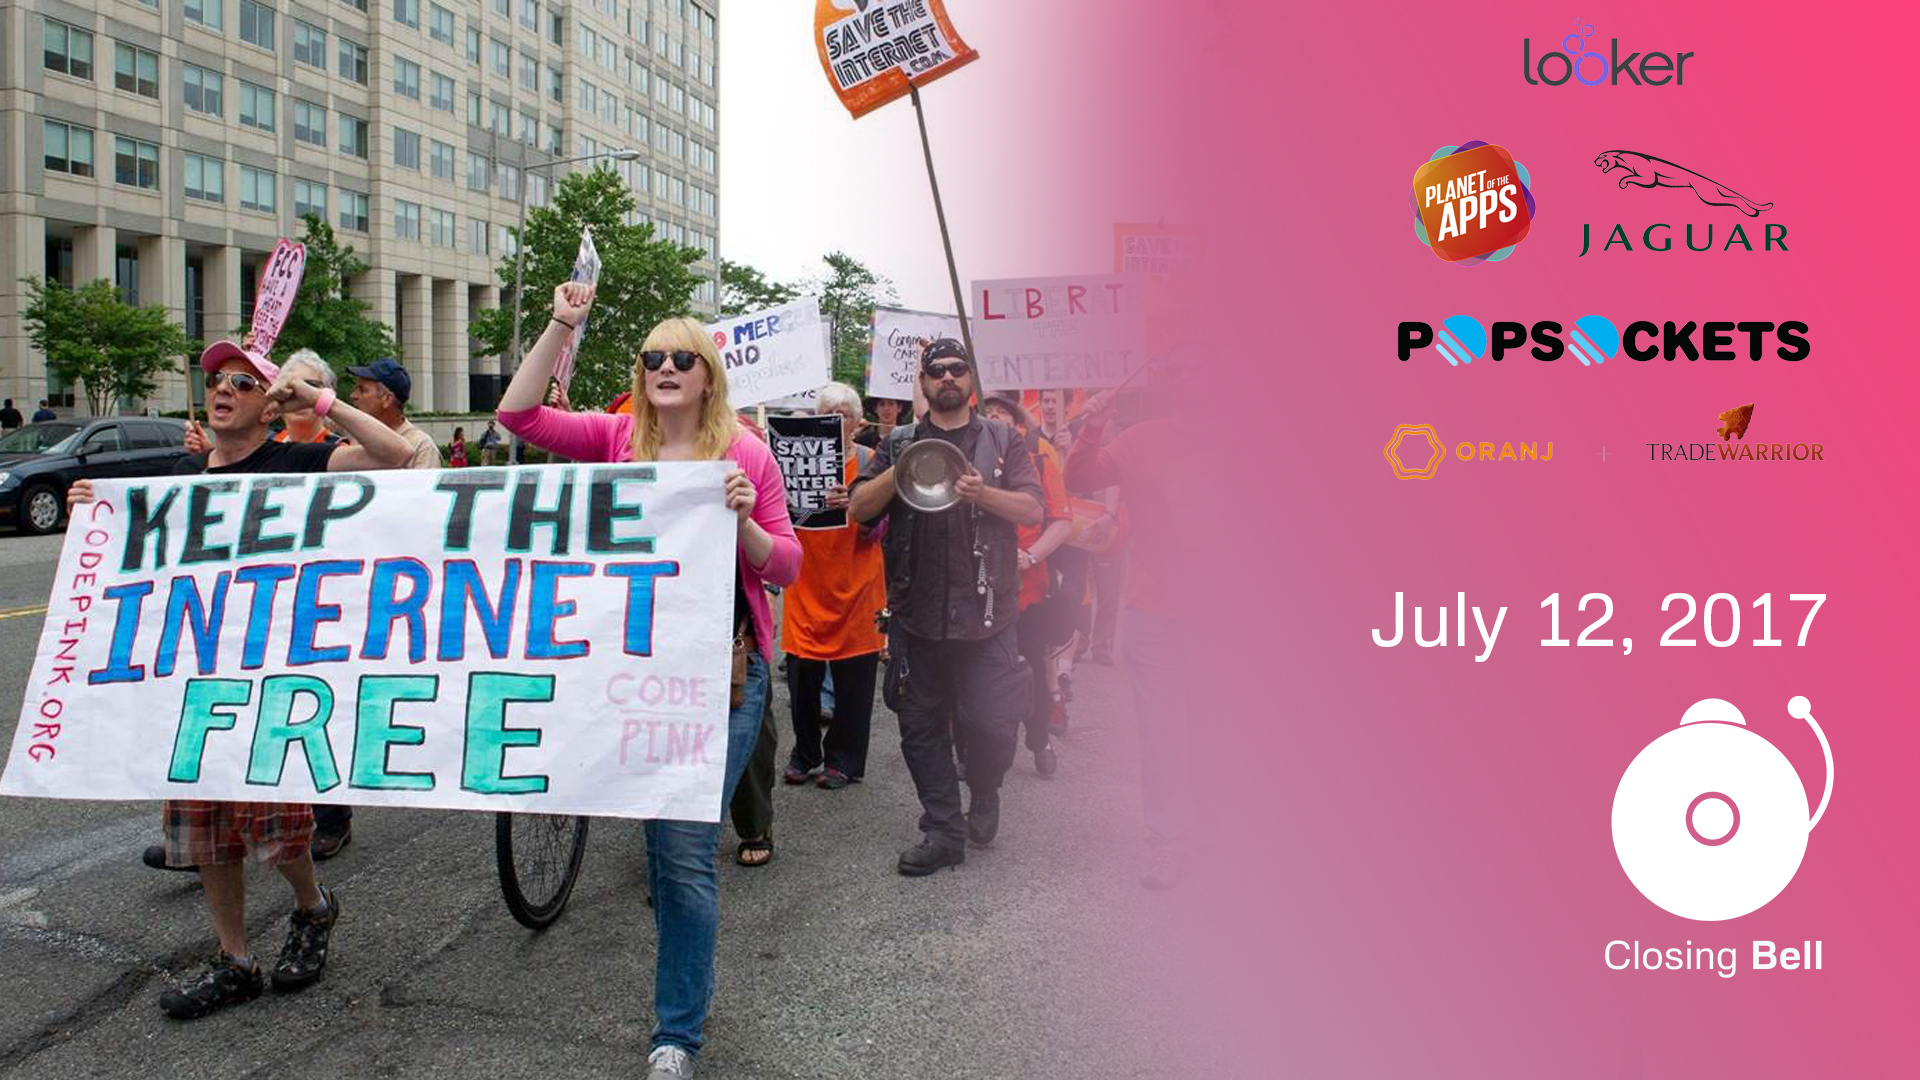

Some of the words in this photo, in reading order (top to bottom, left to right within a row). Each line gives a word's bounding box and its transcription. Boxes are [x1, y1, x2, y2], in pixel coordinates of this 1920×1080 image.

[826, 7, 890, 60] SAVE
[887, 0, 927, 30] THE
[834, 23, 940, 88] INTERNET
[270, 246, 298, 279] FCC
[777, 440, 836, 456] SAVE
[778, 456, 837, 476] THE
[119, 473, 377, 574] KEEP
[433, 464, 658, 556] THE
[87, 556, 680, 686] INTERNET
[606, 672, 707, 708] CODE
[167, 671, 556, 794] FREE
[618, 719, 716, 767] PINK
